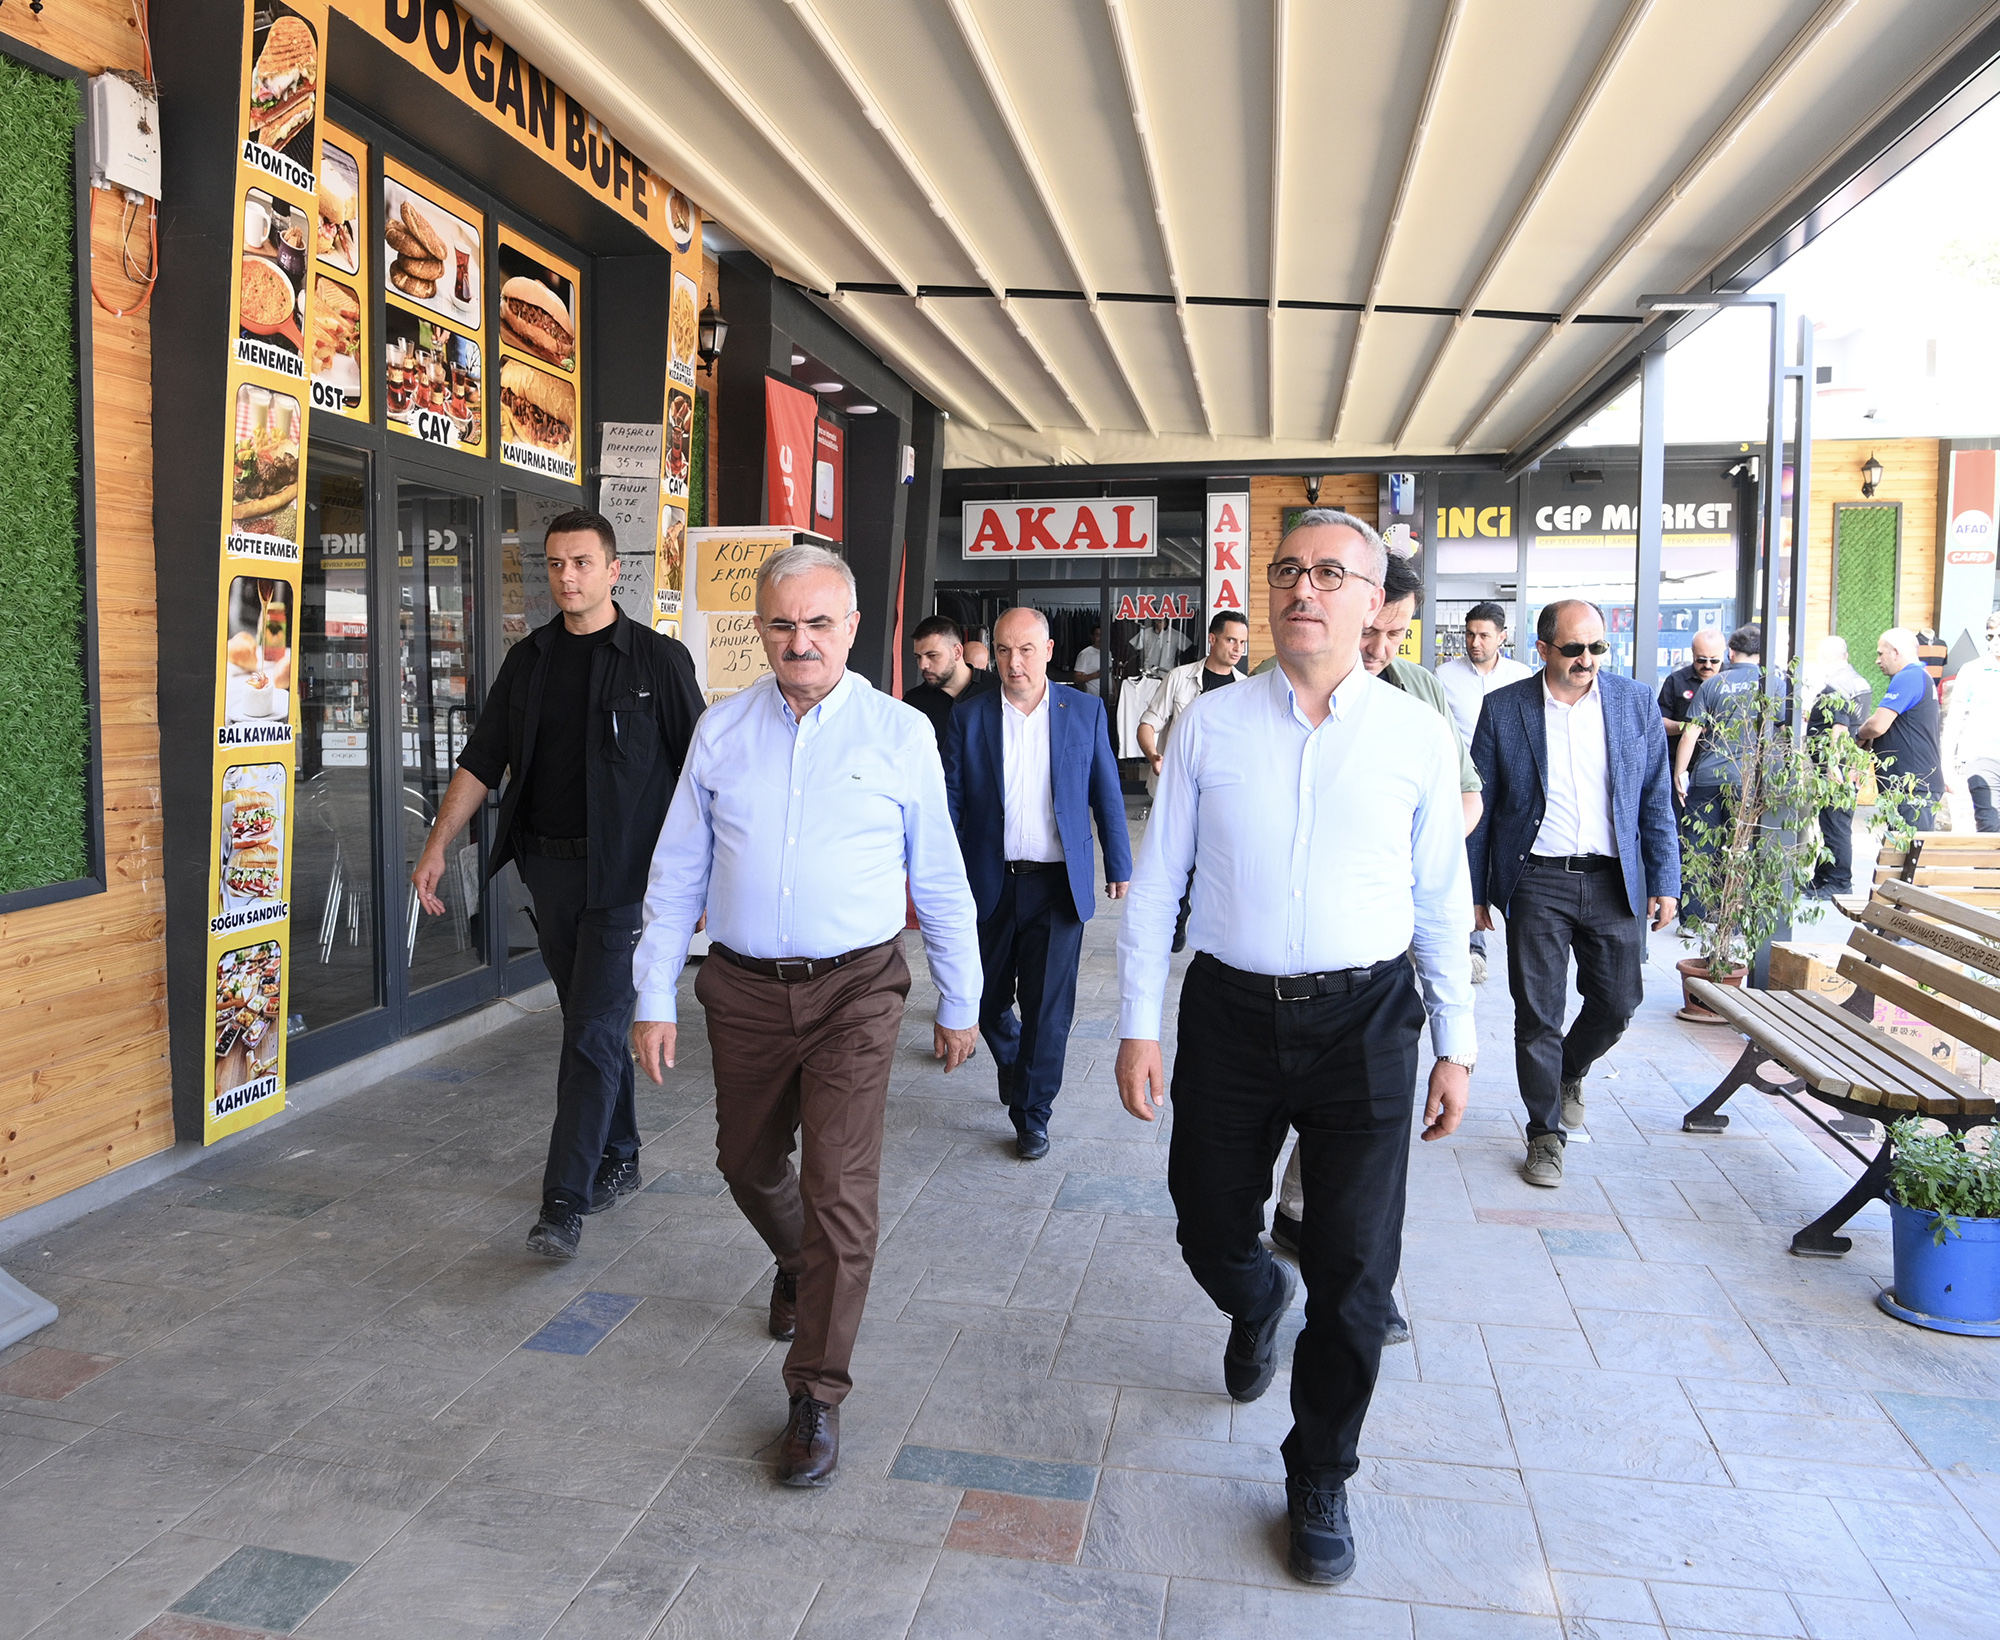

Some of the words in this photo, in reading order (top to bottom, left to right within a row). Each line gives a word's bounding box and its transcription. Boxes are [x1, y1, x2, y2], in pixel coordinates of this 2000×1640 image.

[244, 142, 283, 177] ATOM
[285, 162, 315, 192] TOST
[565, 92, 648, 222] BÜFE
[238, 341, 303, 377] MENEMEN
[309, 382, 343, 410] OST
[418, 411, 451, 444] ÇAY
[609, 426, 655, 438] KAŞARLI
[606, 443, 658, 453] MENEMEN
[503, 443, 546, 473] KAVURMA
[548, 457, 575, 479] EKMEK
[616, 457, 630, 468] 35
[610, 482, 648, 493] TAVUK
[669, 479, 683, 499] ÇAY
[608, 498, 638, 507] SOTE
[614, 512, 632, 524] 50
[1535, 505, 1592, 531] CEP
[1601, 503, 1732, 531] MRKET
[968, 505, 1148, 552] AKAL
[1955, 524, 1988, 534] AFAD
[227, 533, 262, 555] KÖFTE
[263, 541, 298, 559] EKMEK
[1213, 503, 1242, 608] AKA
[620, 560, 643, 568] FTE
[618, 573, 643, 581] MEK
[711, 567, 760, 582] EKME
[611, 585, 625, 596] 60
[729, 582, 752, 602] 60
[660, 602, 677, 613] EKMEK
[1116, 594, 1195, 620] AKAL
[709, 635, 761, 648] KAVURM
[723, 649, 752, 671] 25
[218, 728, 242, 744] BAL
[243, 726, 292, 743] KAYMAK
[210, 911, 246, 932] SOĞUK
[246, 901, 289, 924] SANDVİÇ
[1888, 915, 1943, 947] KAHRAMANMARAŞ
[1940, 937, 1985, 962] BÜYÜKŞEHİR
[215, 1078, 277, 1116] KAHVALTI
